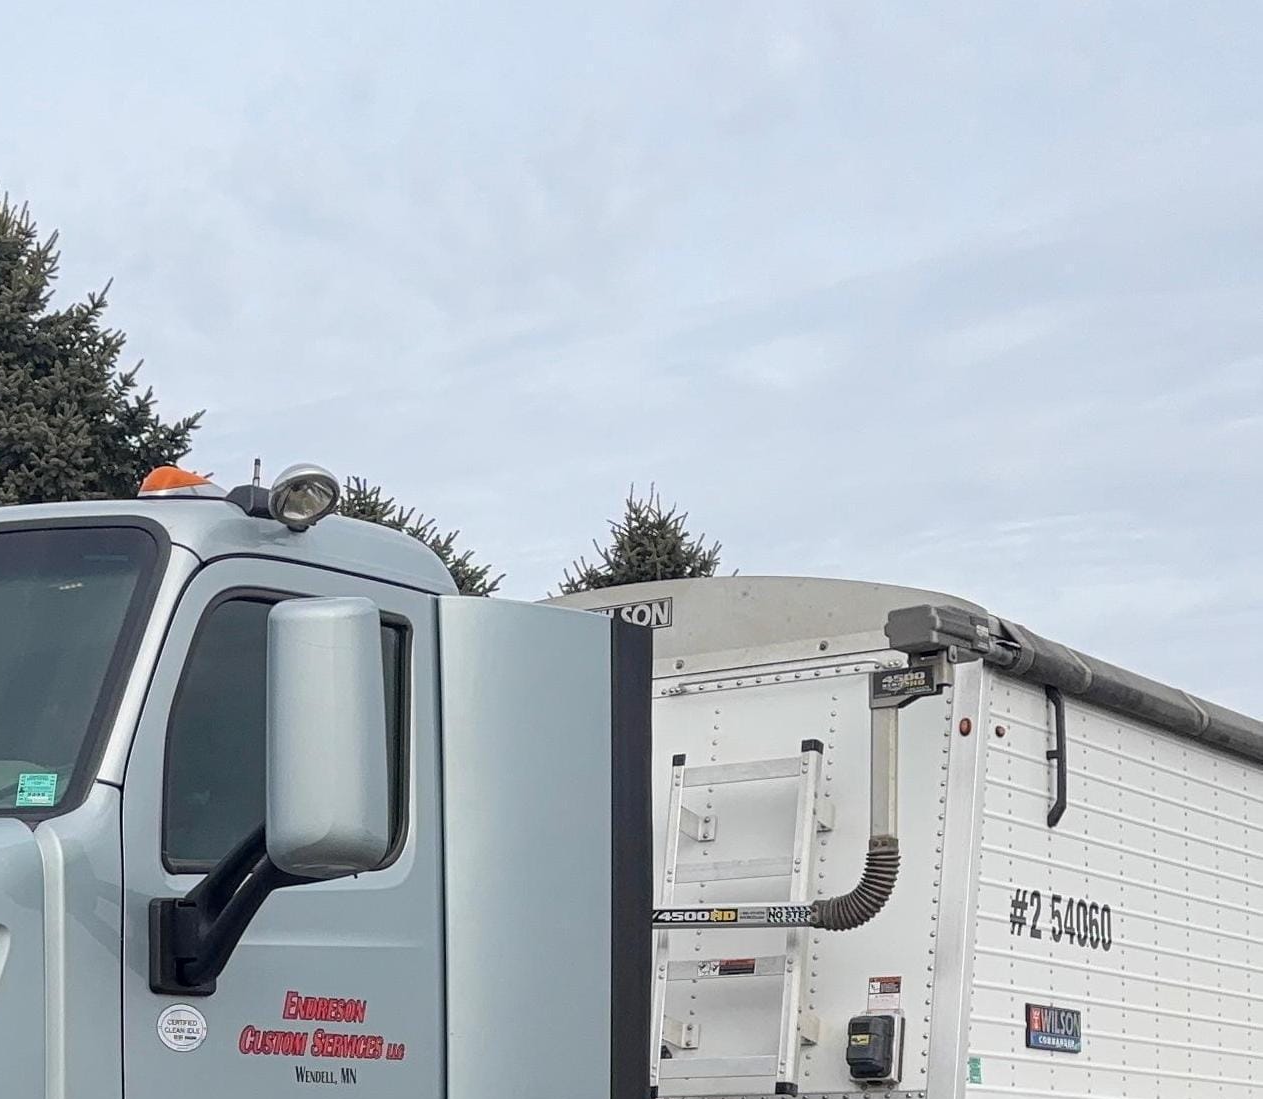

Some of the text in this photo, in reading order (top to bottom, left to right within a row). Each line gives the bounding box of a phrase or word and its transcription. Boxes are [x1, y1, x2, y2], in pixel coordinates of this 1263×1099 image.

[601, 601, 669, 626] SON
[769, 911, 783, 919] NO
[785, 910, 811, 919] STEP
[1010, 889, 1112, 951] #2 54060
[282, 991, 368, 1024] ENDRESON
[1041, 1008, 1081, 1037] WILSON
[239, 1025, 309, 1057] CUSTOM
[311, 1028, 384, 1060] SERVICES
[295, 1066, 357, 1084] WENDELL, MN
